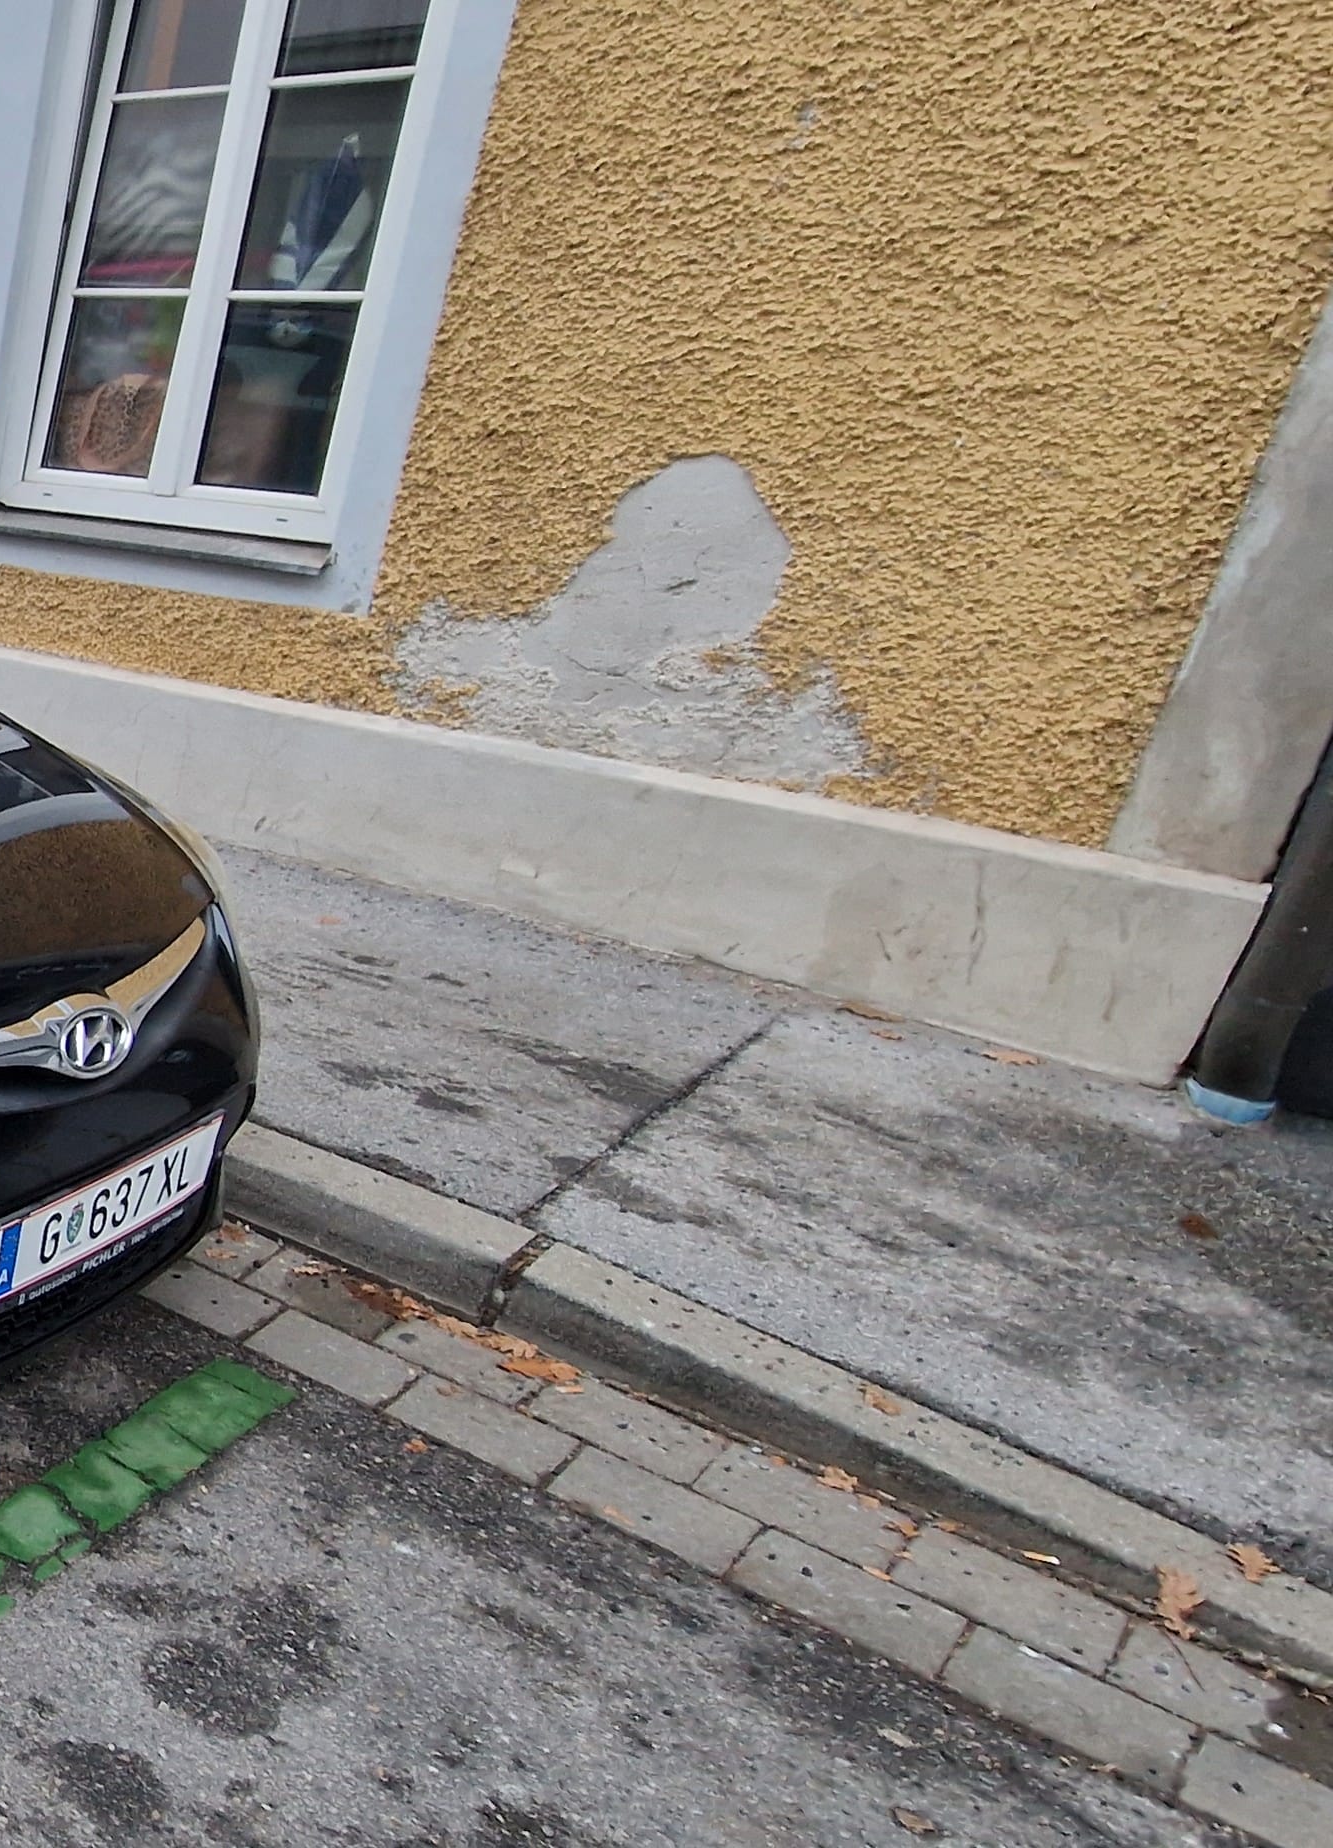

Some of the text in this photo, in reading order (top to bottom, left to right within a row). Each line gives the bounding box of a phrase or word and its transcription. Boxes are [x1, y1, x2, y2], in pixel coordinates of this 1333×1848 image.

[39, 1212, 63, 1265] G
[88, 1165, 155, 1240] 637
[157, 1146, 189, 1205] XL
[81, 1241, 126, 1273] PICHLER
